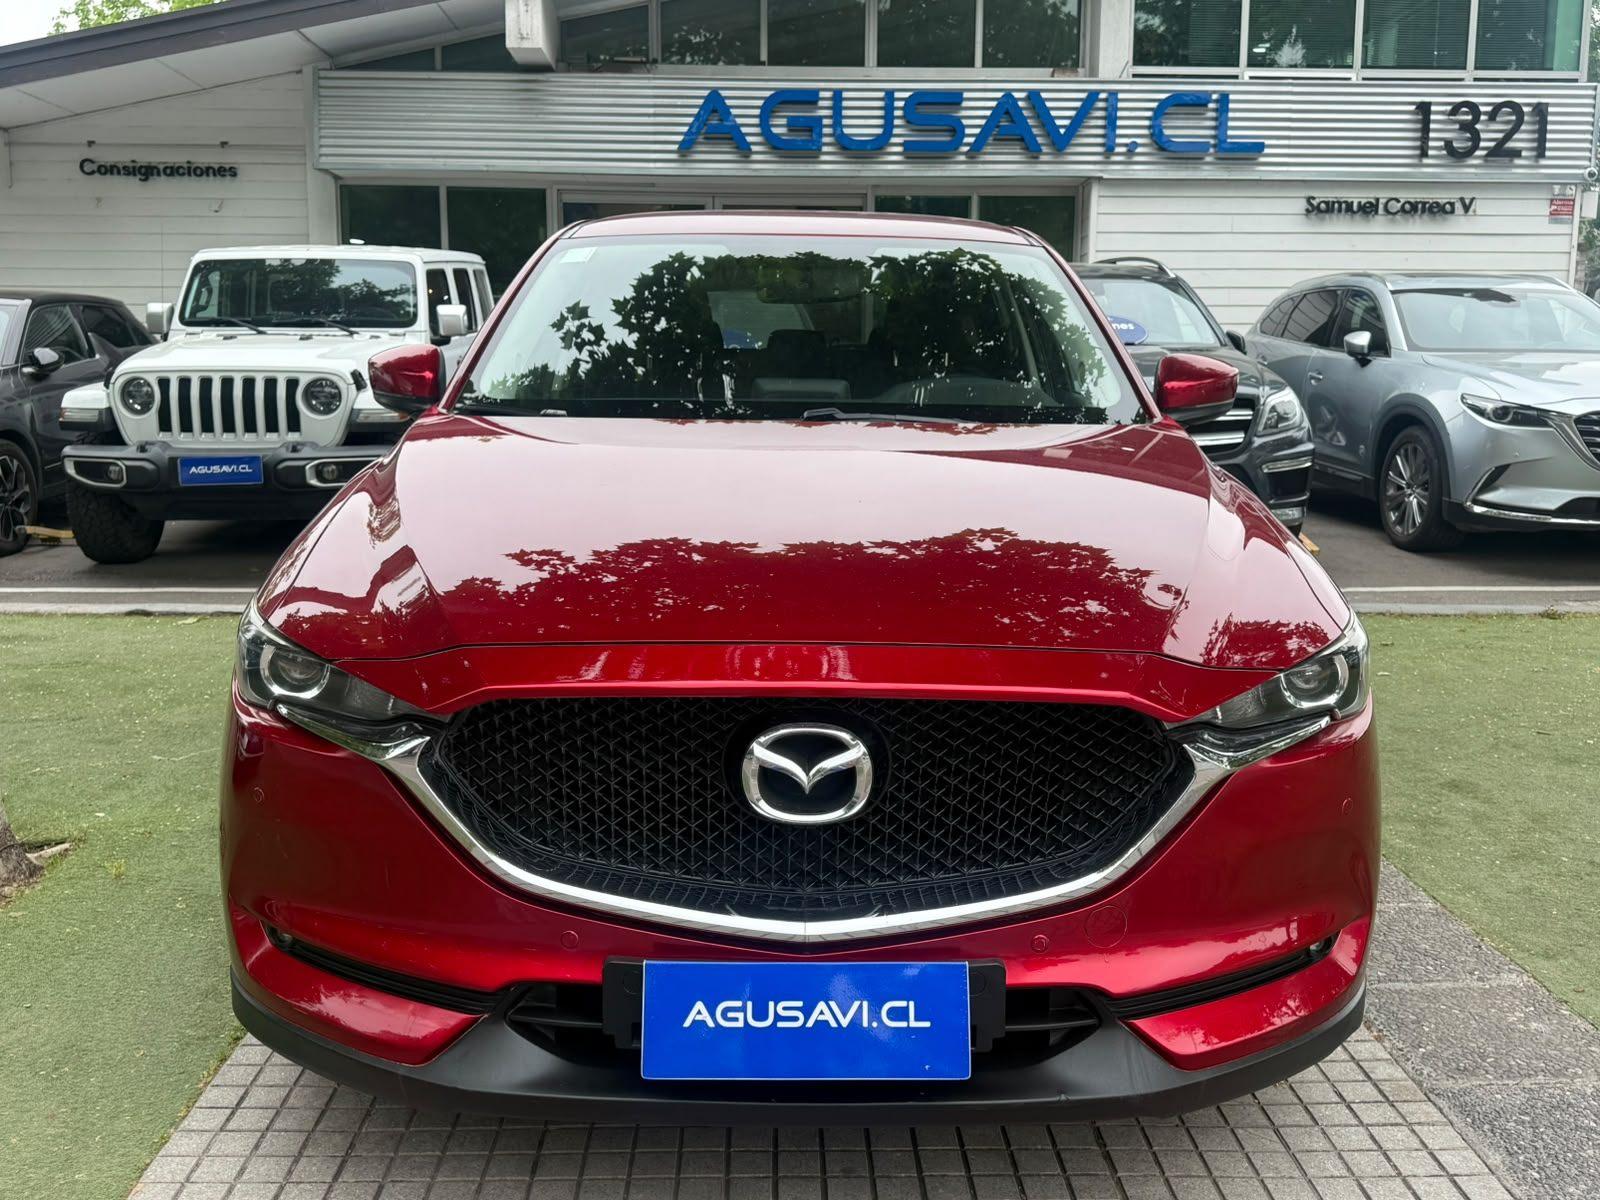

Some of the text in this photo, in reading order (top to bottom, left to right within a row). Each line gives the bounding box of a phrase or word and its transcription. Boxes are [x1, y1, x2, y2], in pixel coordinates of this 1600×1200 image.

[677, 89, 1265, 155] AGUSAVI.CL
[1415, 100, 1549, 158] 1321
[79, 158, 237, 182] Consignaciones
[1305, 196, 1379, 215] Samuel
[1384, 197, 1455, 215] Correa
[189, 464, 253, 474] AGUSAVI.CL
[682, 1000, 931, 1028] AGUSAVI.CL
